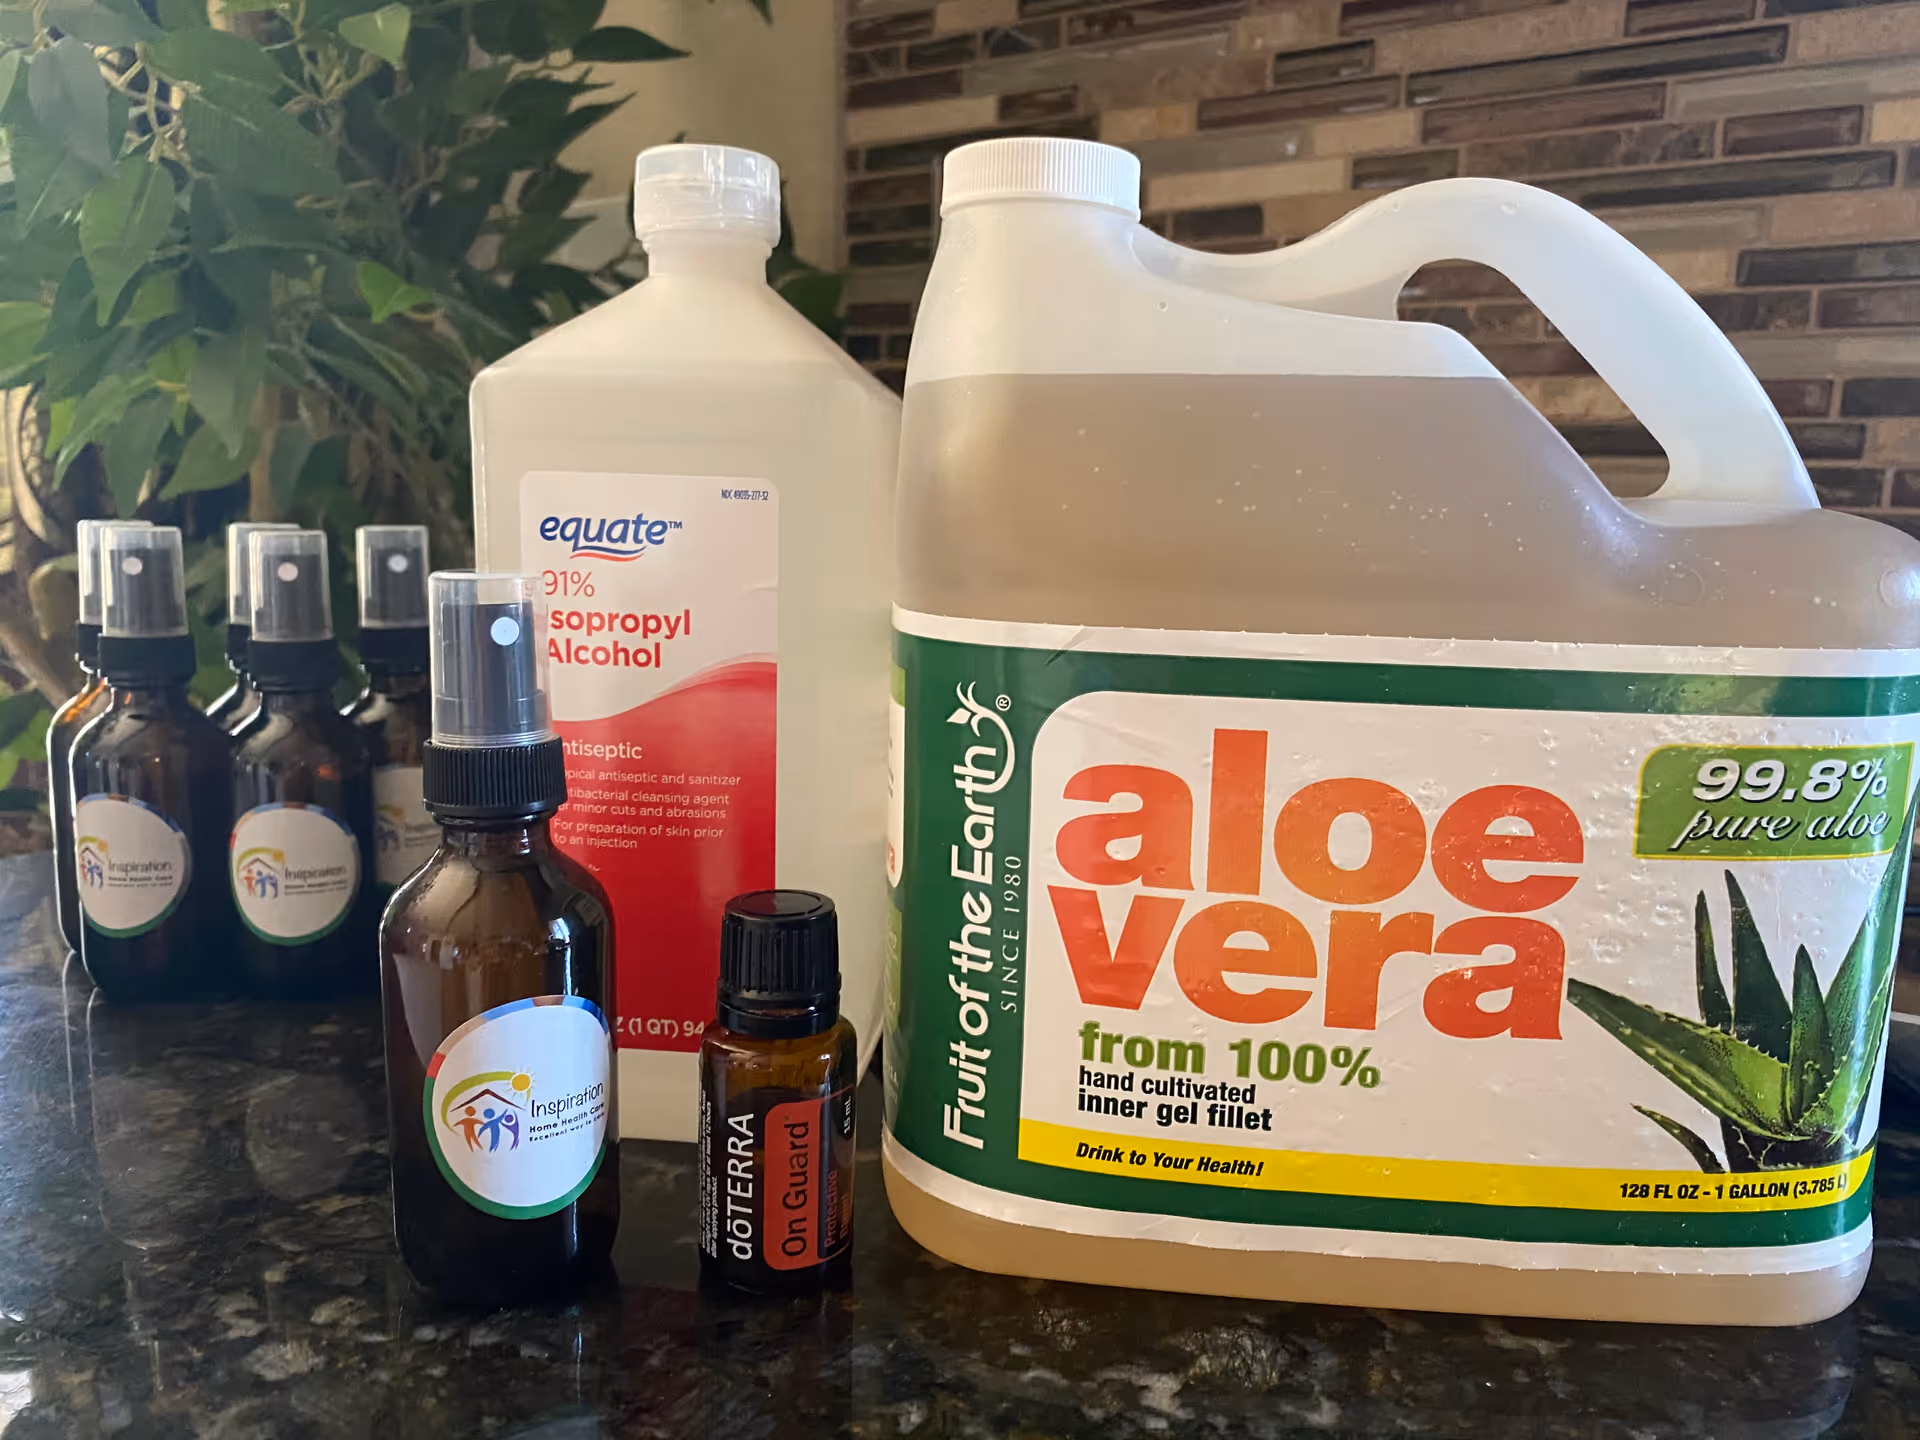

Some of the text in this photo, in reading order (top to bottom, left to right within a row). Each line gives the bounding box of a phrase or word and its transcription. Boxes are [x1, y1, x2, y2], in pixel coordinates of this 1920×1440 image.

[542, 570, 595, 597] 91%
[547, 608, 691, 640] sopropyl
[548, 637, 661, 668] Alcohol
[562, 739, 643, 761] ntiseptic
[565, 768, 741, 785] opical antiseptic and sanitizer
[1692, 758, 1888, 805] 99.8%
[558, 802, 726, 818] or minor cuts and abrasions
[568, 787, 729, 806] tibacterial cleansing agent
[554, 819, 724, 839] For preparation of skin prior
[951, 745, 1013, 885] Earth
[1055, 728, 1584, 914] aloe
[1666, 806, 1893, 852] pure aloe
[554, 833, 637, 849] to an injection
[108, 858, 172, 876] Inspiration
[949, 891, 993, 973] the
[1000, 855, 1022, 1013] SINCE 1980
[1047, 884, 1566, 1041] vera
[949, 973, 989, 1036] of
[683, 1020, 705, 1037] 94
[1078, 1020, 1382, 1089] from 100%
[531, 1082, 604, 1120] Inspiration
[943, 1040, 991, 1150] Fruit
[1078, 1065, 1257, 1105] hand cultivated
[529, 1123, 558, 1133] Home
[561, 1111, 588, 1126] Health
[1078, 1088, 1273, 1131] inner gel fillet
[529, 1128, 567, 1142] Excellent
[1075, 1142, 1265, 1177] Drink to Your Health!
[781, 1121, 809, 1257] On Guard
[1620, 1183, 1650, 1198] 128
[1653, 1184, 1673, 1199] FL
[1677, 1184, 1700, 1199] OZ
[1714, 1184, 1724, 1199] 1
[1729, 1182, 1790, 1199] GALLON
[1793, 1177, 1835, 1199] (3.785
